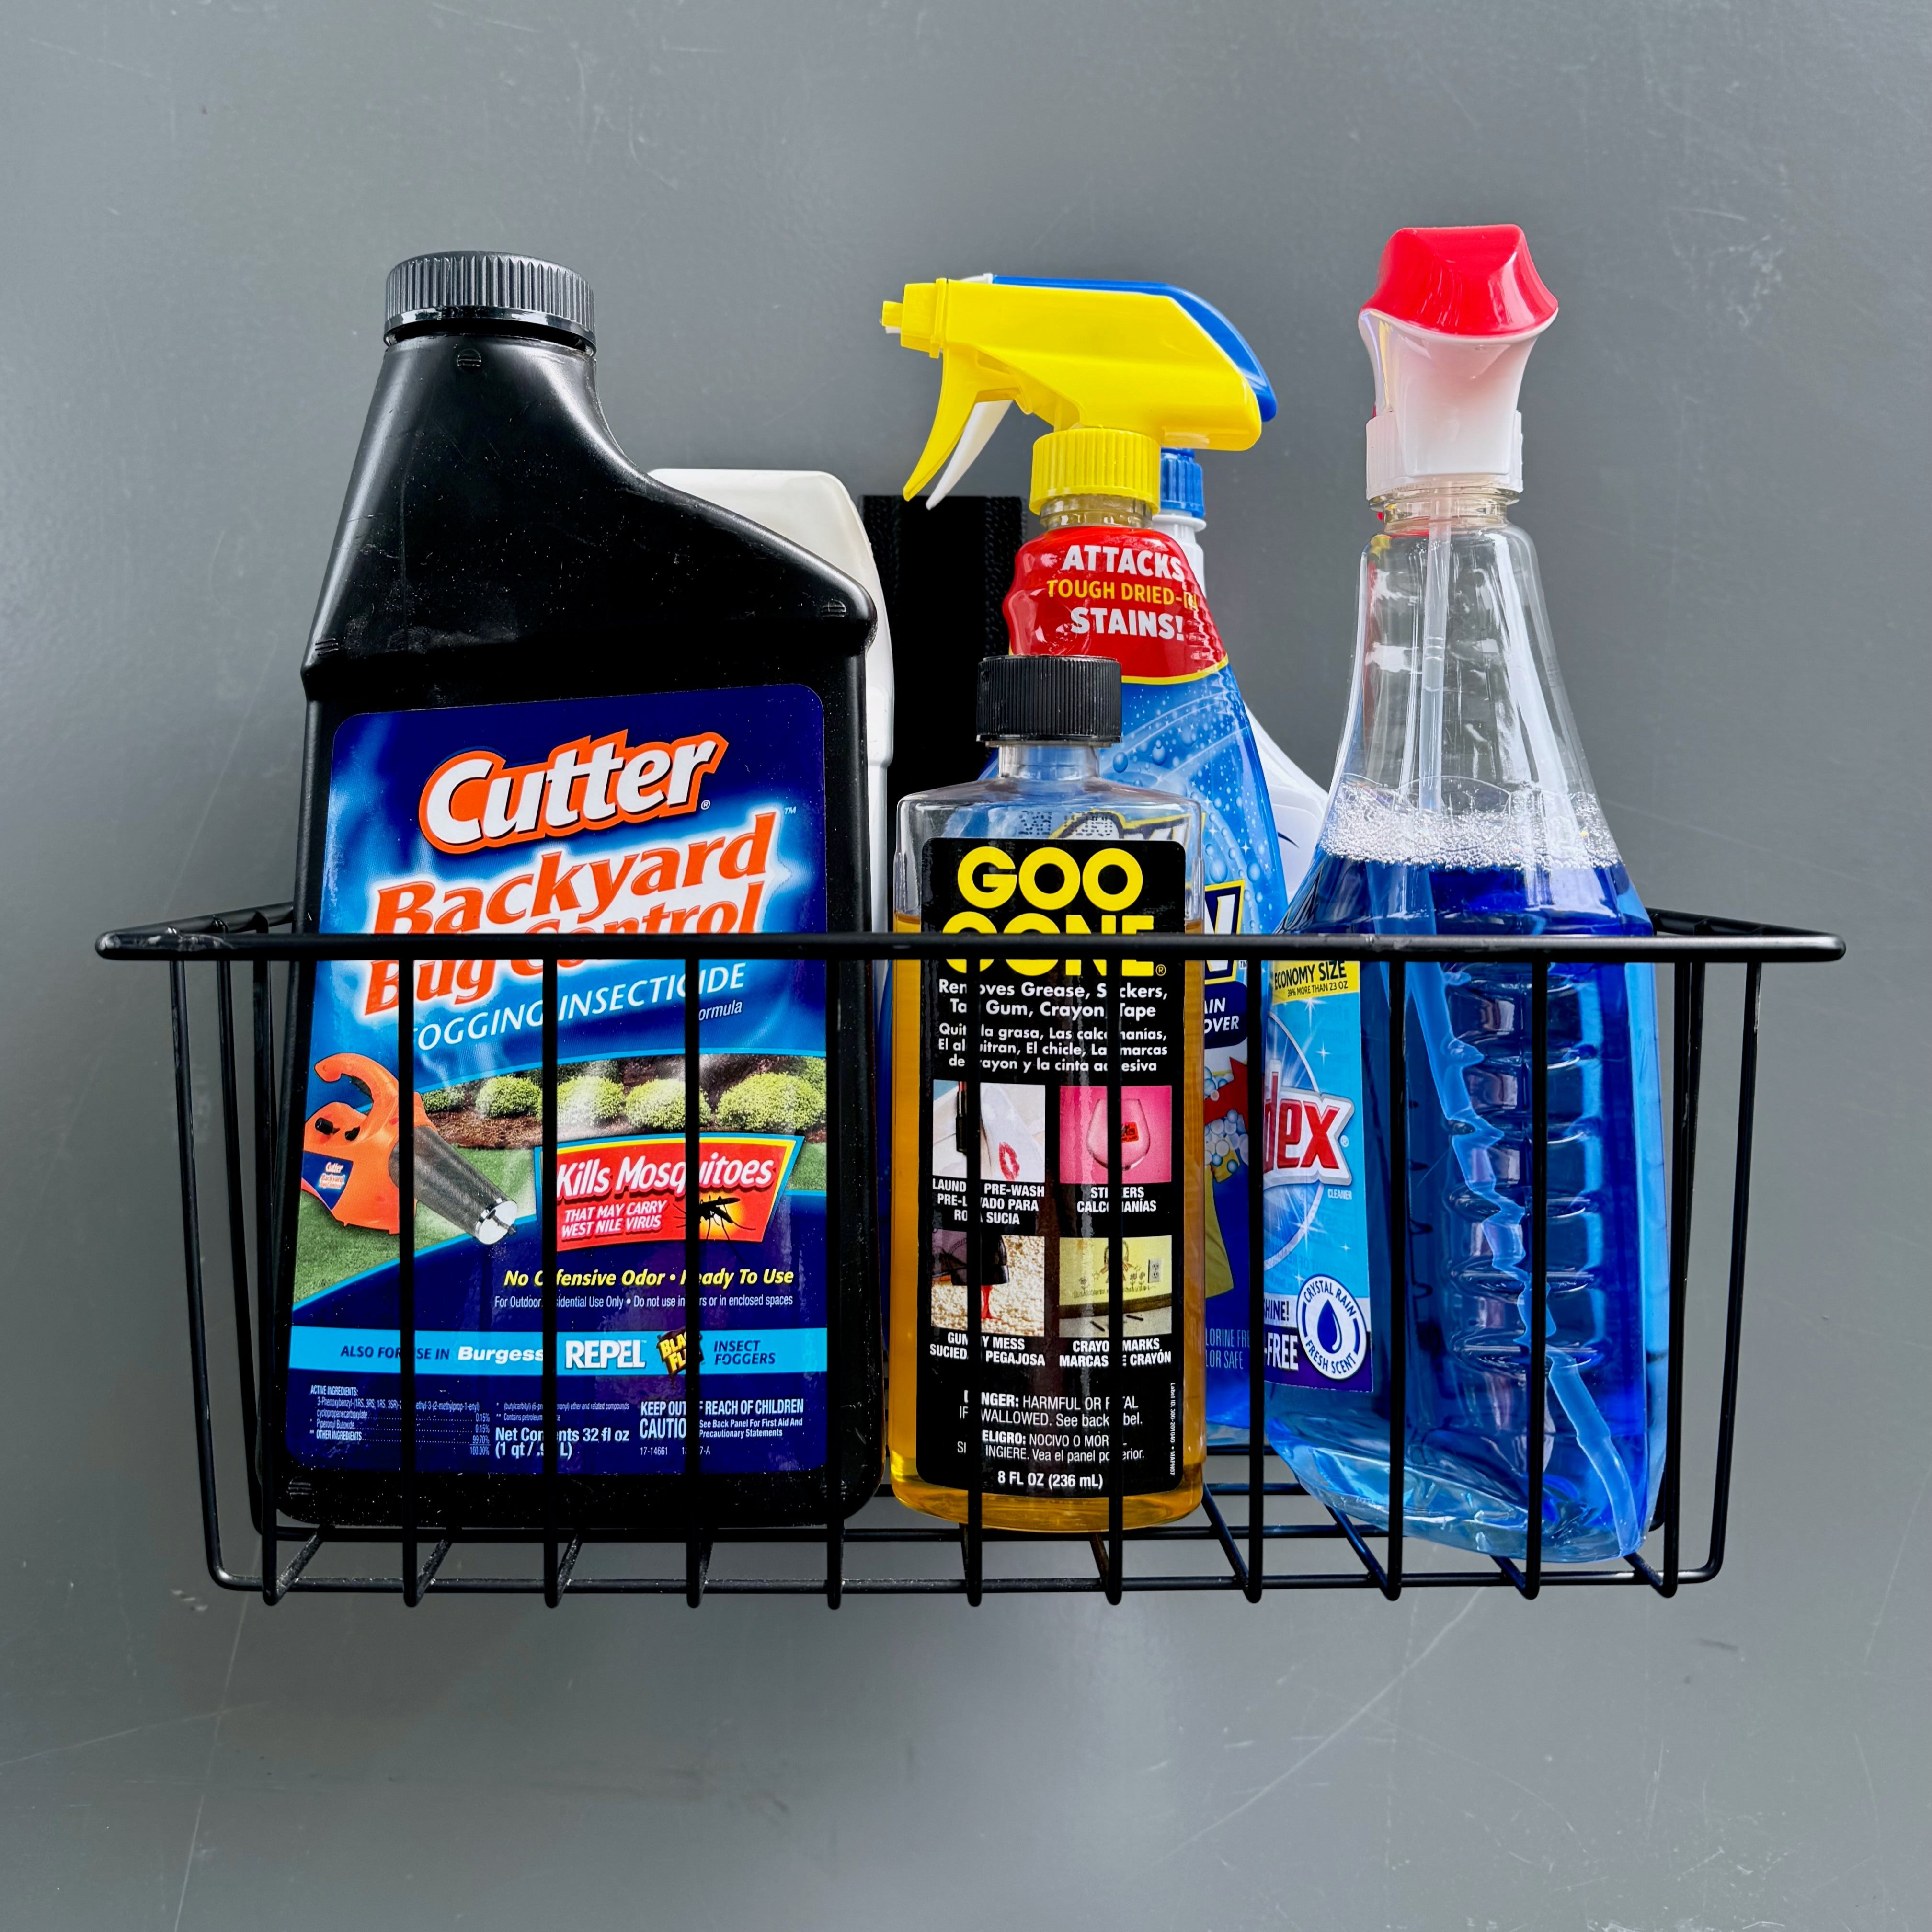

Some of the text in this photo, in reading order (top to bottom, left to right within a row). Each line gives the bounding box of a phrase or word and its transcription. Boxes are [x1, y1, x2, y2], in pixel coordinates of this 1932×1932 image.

[1061, 544, 1185, 582] ATTACKS
[1046, 579, 1115, 599] TOUGH
[1070, 607, 1185, 641] STAINS!
[424, 739, 718, 845] Cutter
[374, 812, 778, 933] Backyard
[958, 846, 1143, 911] GOO
[1275, 960, 1347, 990] ECONOMY SIZE
[1021, 982, 1167, 1000] Grease, Sckers,
[1288, 981, 1348, 997] 39% MORE THAN 23 OZ
[698, 999, 743, 1021] ormula
[986, 999, 1156, 1021] Gum, Crayon Tape
[414, 999, 543, 1050] OGGING
[939, 1022, 1072, 1041] Quit la grasa, Las
[938, 1038, 1167, 1057] El El chicle, marcas
[949, 1053, 1089, 1073] de y la cinta
[557, 1158, 610, 1197] Kills
[984, 1183, 1045, 1198] PRE-WASH
[1091, 1186, 1144, 1198] STIERS
[1327, 1189, 1352, 1200] CLEANER
[565, 1200, 667, 1223] THAT MAY CARRY
[1008, 1199, 1039, 1212] PARA
[561, 1215, 661, 1237] WEST NILE VIRUS
[986, 1212, 1020, 1225] SUCIA
[503, 1268, 794, 1286] No Ofensive Odor To Use
[495, 1294, 793, 1309] For Outdoor Use Only Do not use or in enclosed spaces
[1304, 1280, 1356, 1317] CRYSTAL RAIN
[1264, 1299, 1289, 1321] HINE!
[660, 1331, 686, 1359] BLA
[714, 1340, 761, 1352] INSECT
[993, 1337, 1025, 1350] MESS
[1073, 1338, 1160, 1352] CRAYO MARKS
[341, 1339, 646, 1369] ALSO FOR SE IN Burgess REPEL
[714, 1352, 776, 1365] FOGGERS
[986, 1350, 1045, 1366] PEGAJOSA
[1059, 1349, 1171, 1367] MARCAS CRAYÓN
[1224, 1350, 1244, 1369] SAFE
[1305, 1340, 1356, 1374] FRESH SCENT
[310, 1385, 358, 1396] ACTIVE INGREDIENTS:
[641, 1401, 666, 1416] KEEP
[705, 1400, 738, 1415] REACH
[741, 1400, 754, 1414] OF
[755, 1398, 804, 1414] CHILDREN
[1022, 1396, 1101, 1411] HARMFUL OR
[476, 1413, 490, 1422] 0.15%
[699, 1418, 803, 1428] See Back Panel For First Aid And
[960, 1405, 1109, 1427] IF WALLOWED. See back
[316, 1430, 490, 1444] OTHER INGREDIENTS 99.70%
[475, 1424, 490, 1433] 0.15%
[495, 1427, 629, 1442] Net 32 fl oz
[640, 1418, 686, 1439] CAUTIO
[699, 1429, 782, 1439] Precautionary Statements
[982, 1429, 1081, 1447] ELIGRO: NOCIVO O
[469, 1446, 490, 1455] 100.00%
[495, 1441, 506, 1459] (1
[511, 1442, 525, 1459] qt
[640, 1446, 668, 1455] 17-14661
[957, 1441, 1096, 1463] SI INGIERE. Vea el panel
[998, 1471, 1103, 1489] 8 FL OZ (236 mL)
